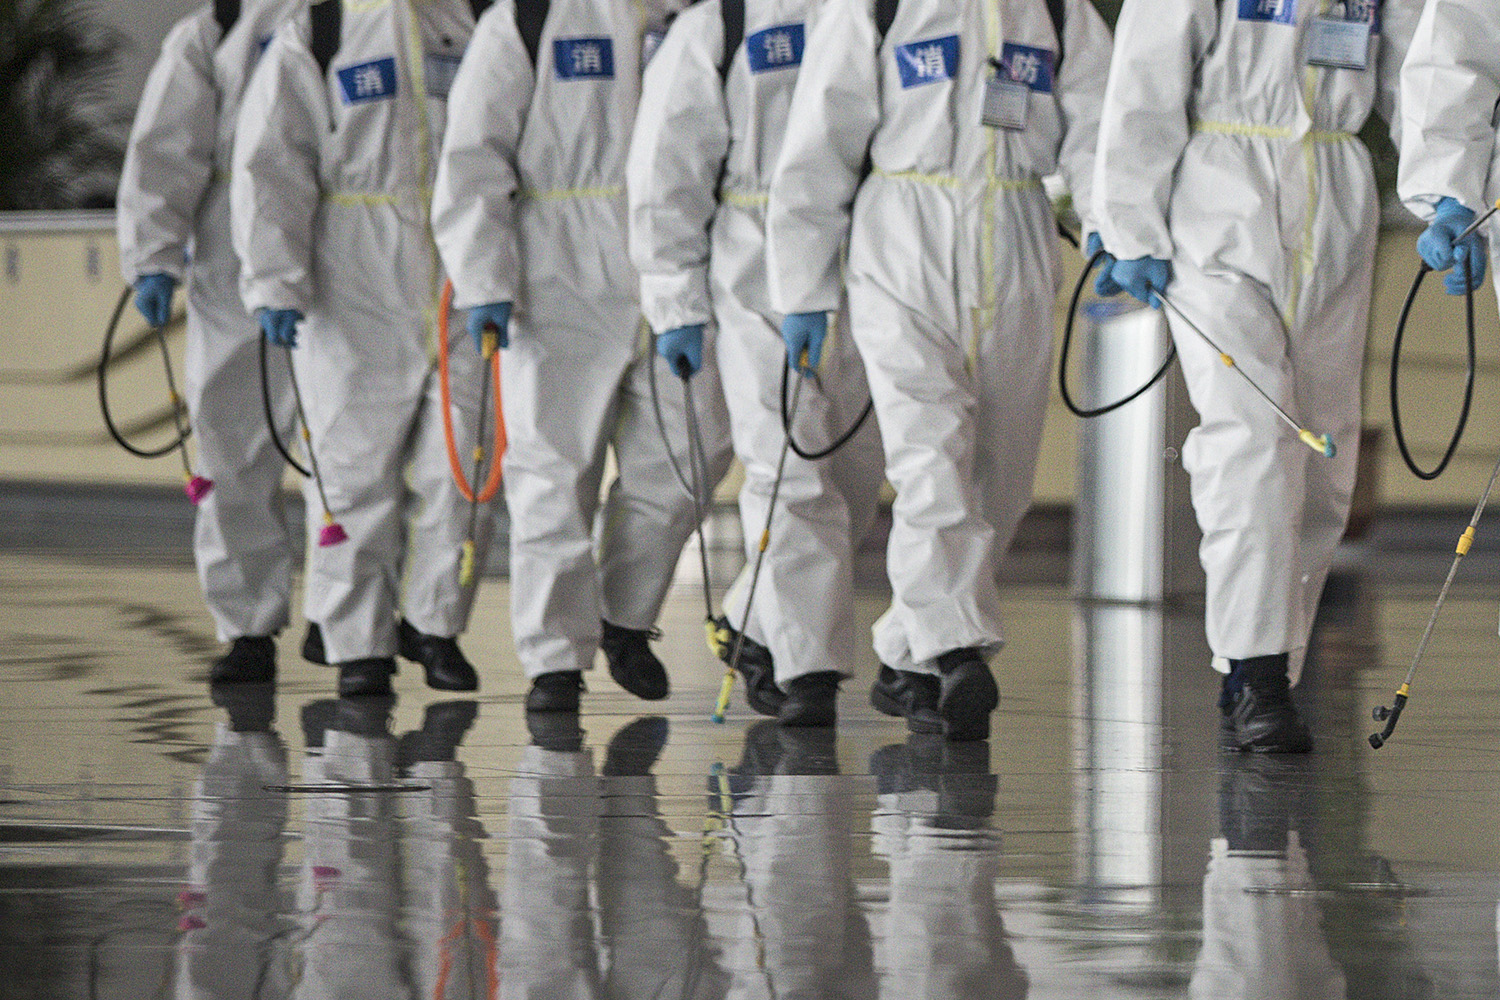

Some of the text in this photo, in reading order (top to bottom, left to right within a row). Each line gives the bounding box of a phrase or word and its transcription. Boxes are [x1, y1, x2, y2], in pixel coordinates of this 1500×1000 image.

[570, 42, 601, 73] 消
[763, 31, 793, 62] 消
[915, 44, 1040, 83] 消 防
[353, 65, 384, 99] 消
